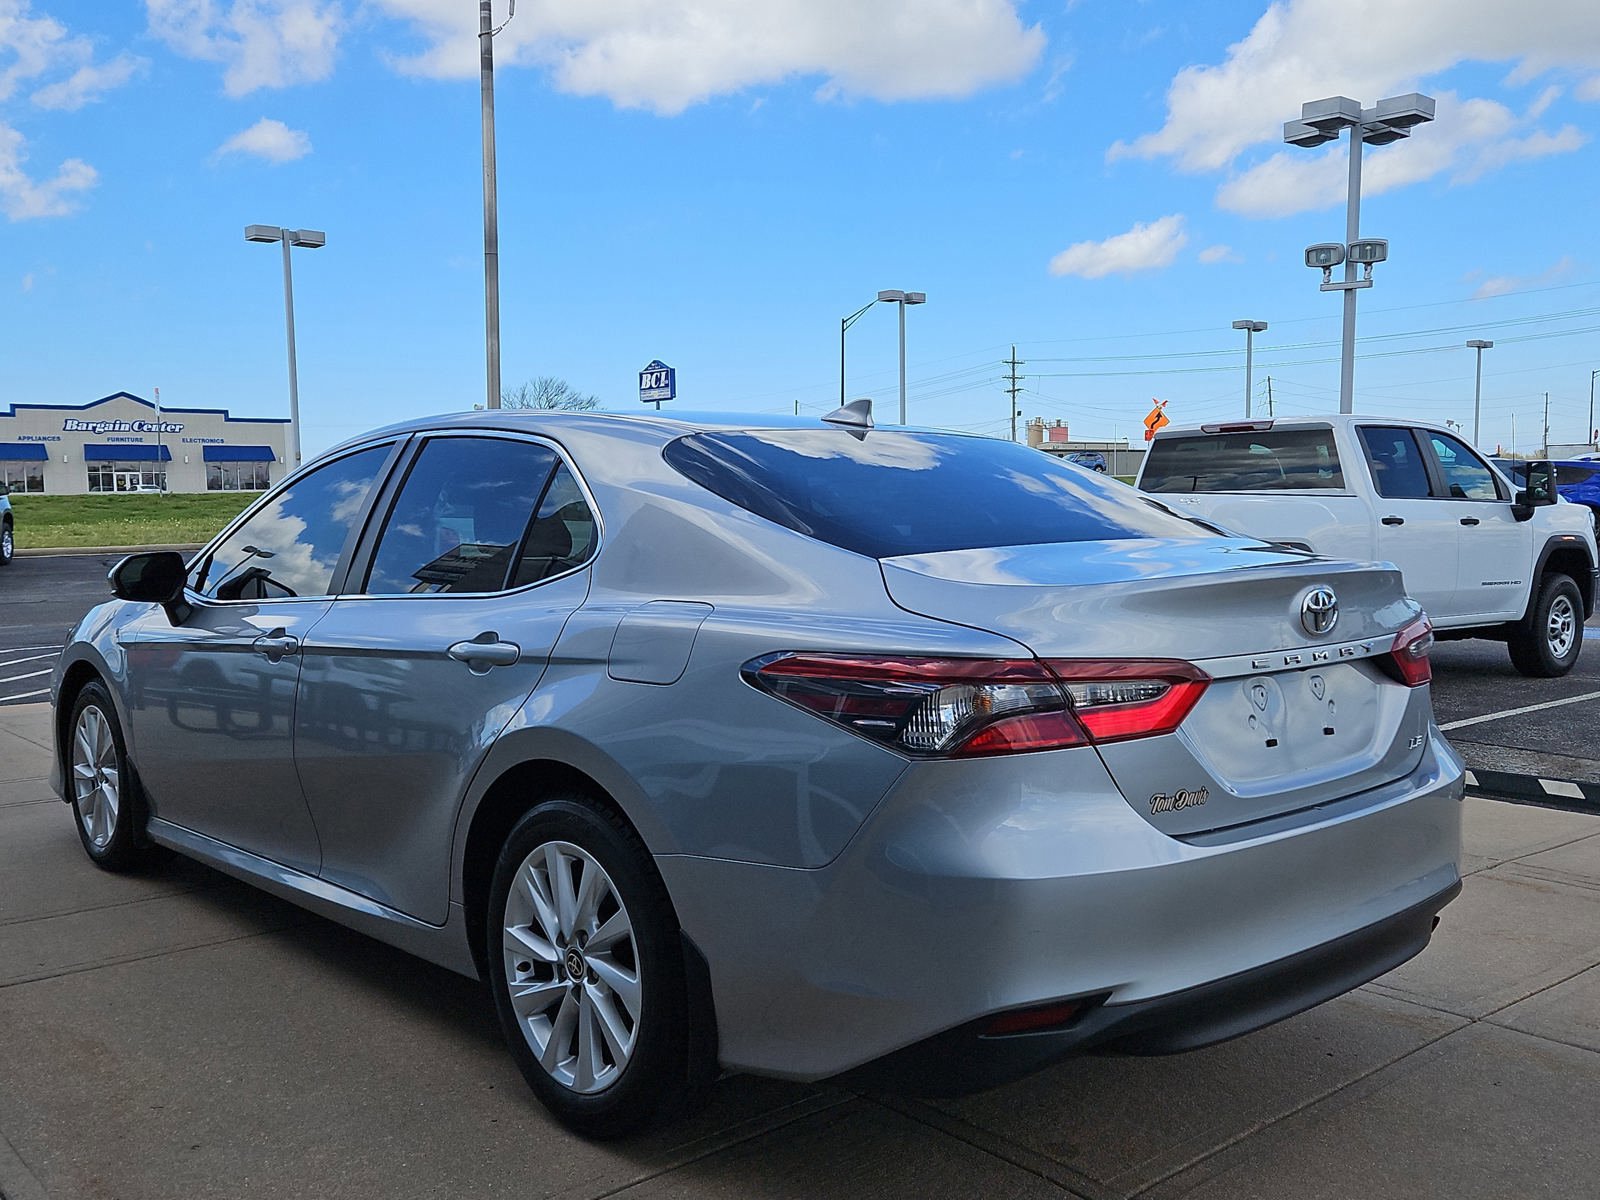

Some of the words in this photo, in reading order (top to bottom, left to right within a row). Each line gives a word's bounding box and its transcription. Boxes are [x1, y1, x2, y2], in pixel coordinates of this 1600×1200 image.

[63, 418, 130, 435] Bargain
[131, 419, 184, 433] Center
[1252, 642, 1375, 670] CAMRY
[1408, 735, 1423, 750] LE
[1150, 793, 1175, 815] Tom
[1174, 786, 1209, 810] Davis
